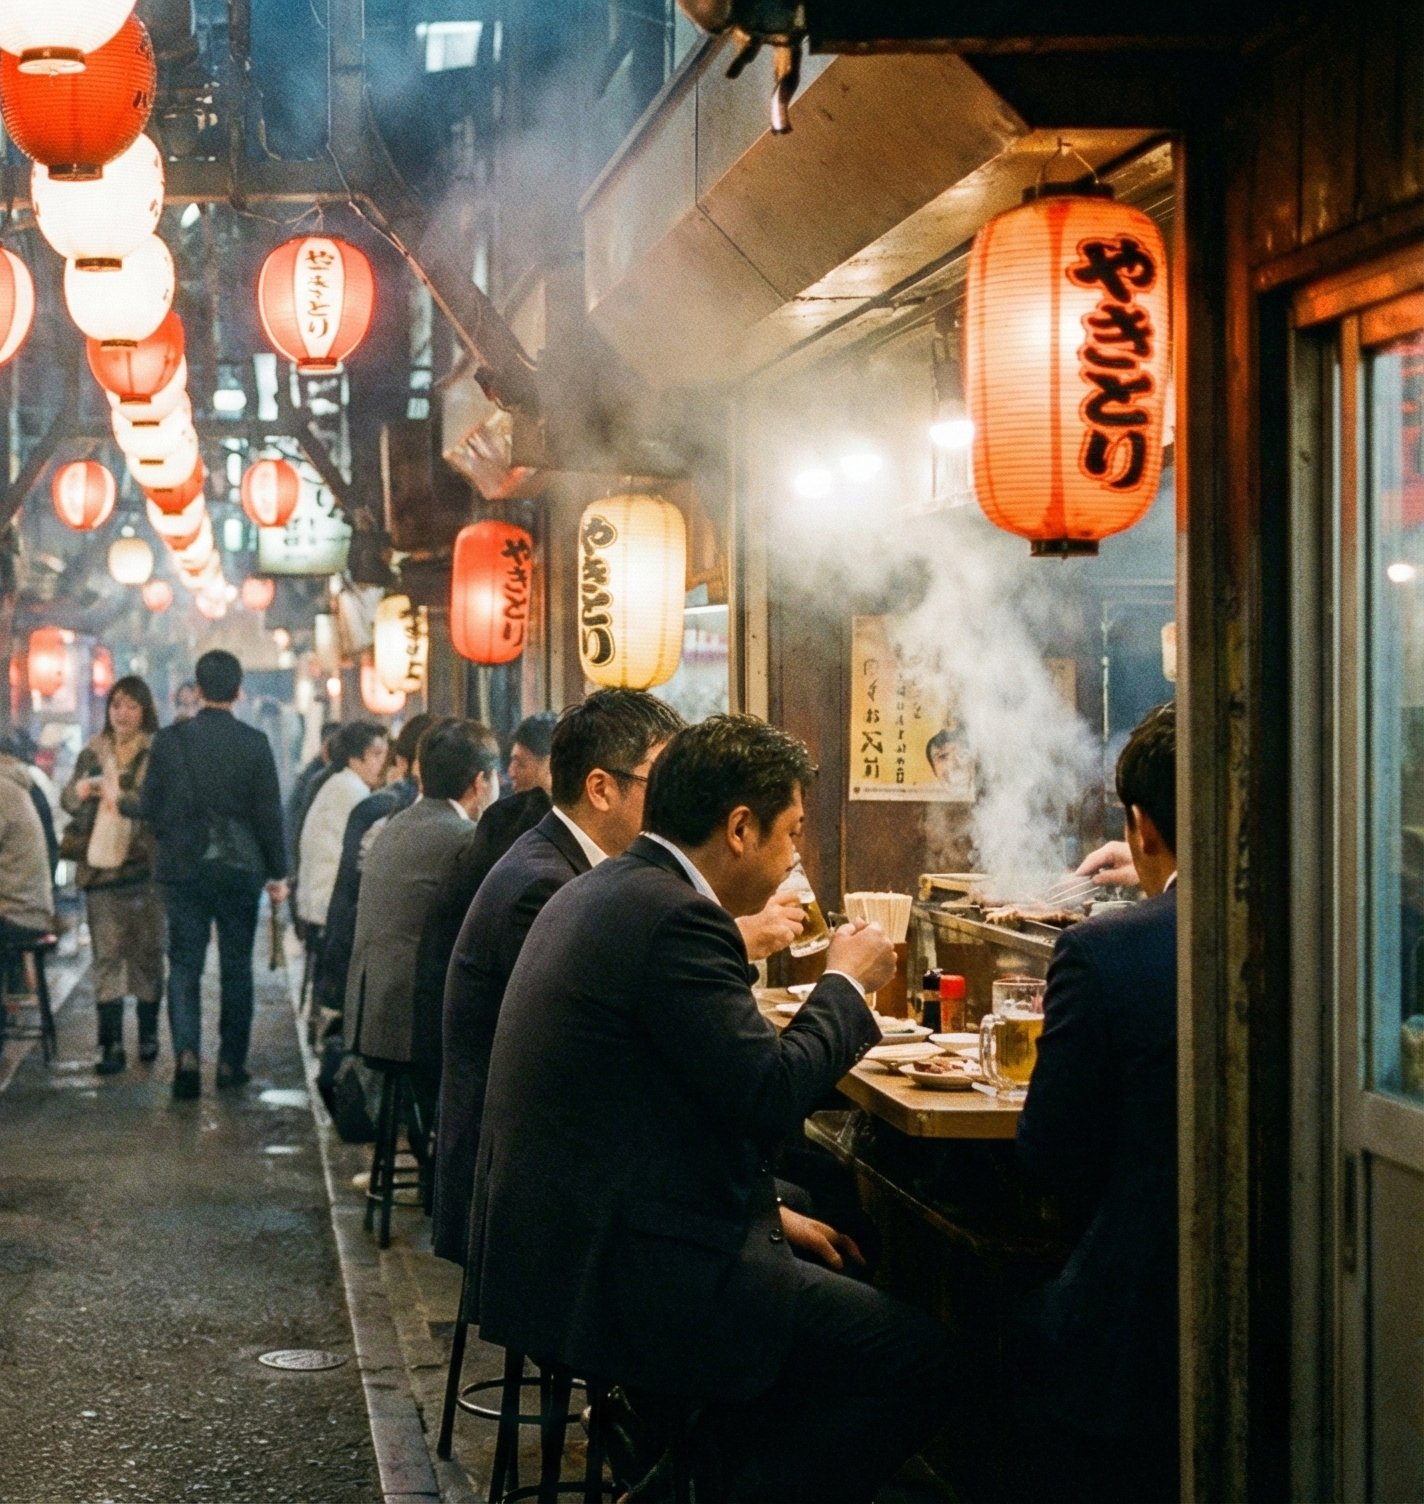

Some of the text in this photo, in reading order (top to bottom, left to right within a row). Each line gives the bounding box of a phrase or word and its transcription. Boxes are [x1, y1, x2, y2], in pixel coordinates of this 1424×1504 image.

[1070, 234, 1156, 492] やきとり
[500, 537, 531, 648] やきとり
